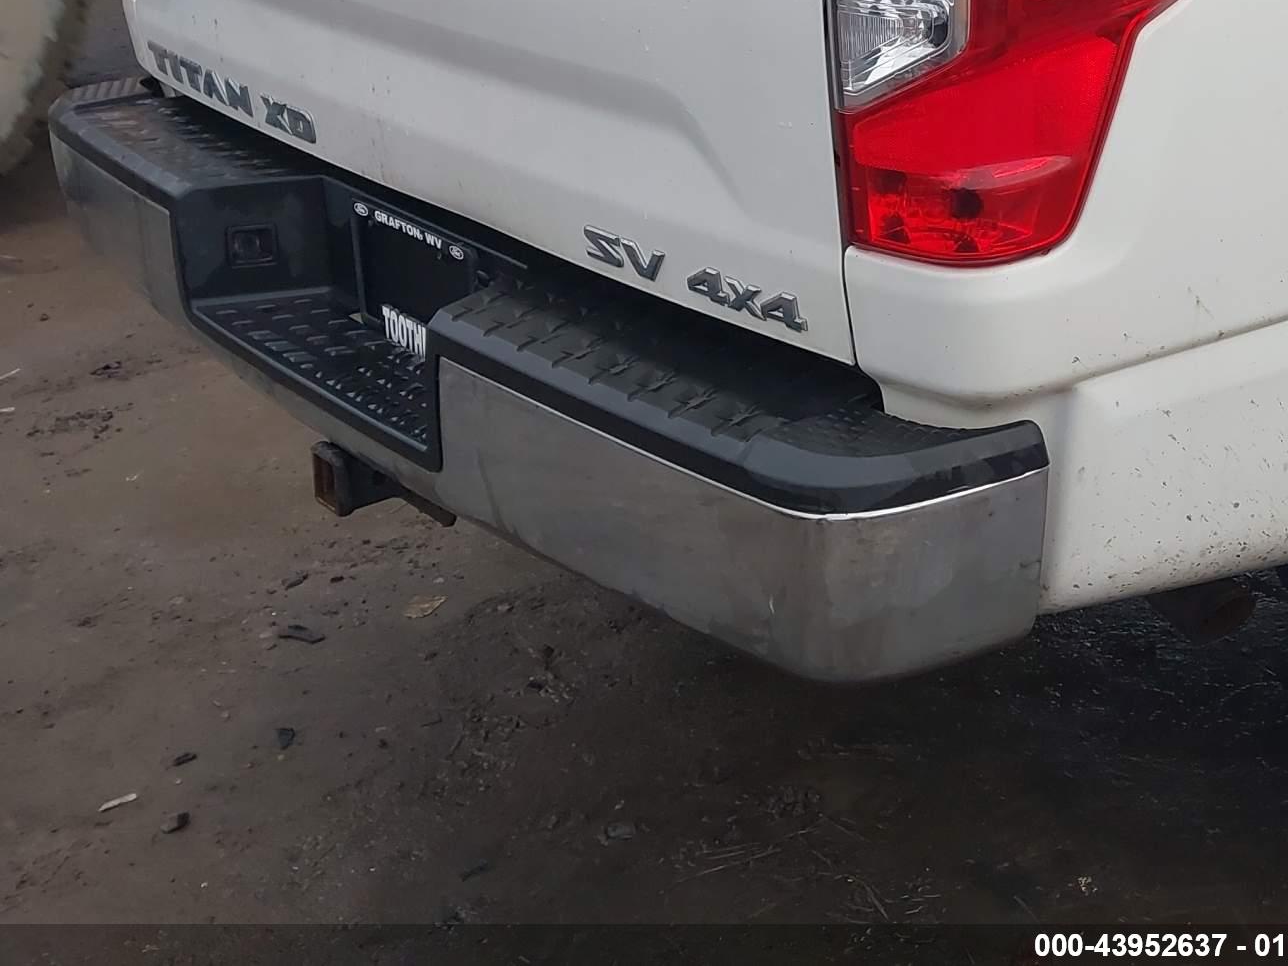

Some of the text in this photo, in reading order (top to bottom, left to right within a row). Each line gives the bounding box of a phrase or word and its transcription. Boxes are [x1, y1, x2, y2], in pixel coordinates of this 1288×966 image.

[146, 40, 318, 144] TITAN XD
[424, 231, 442, 250] WV
[583, 224, 666, 282] SV
